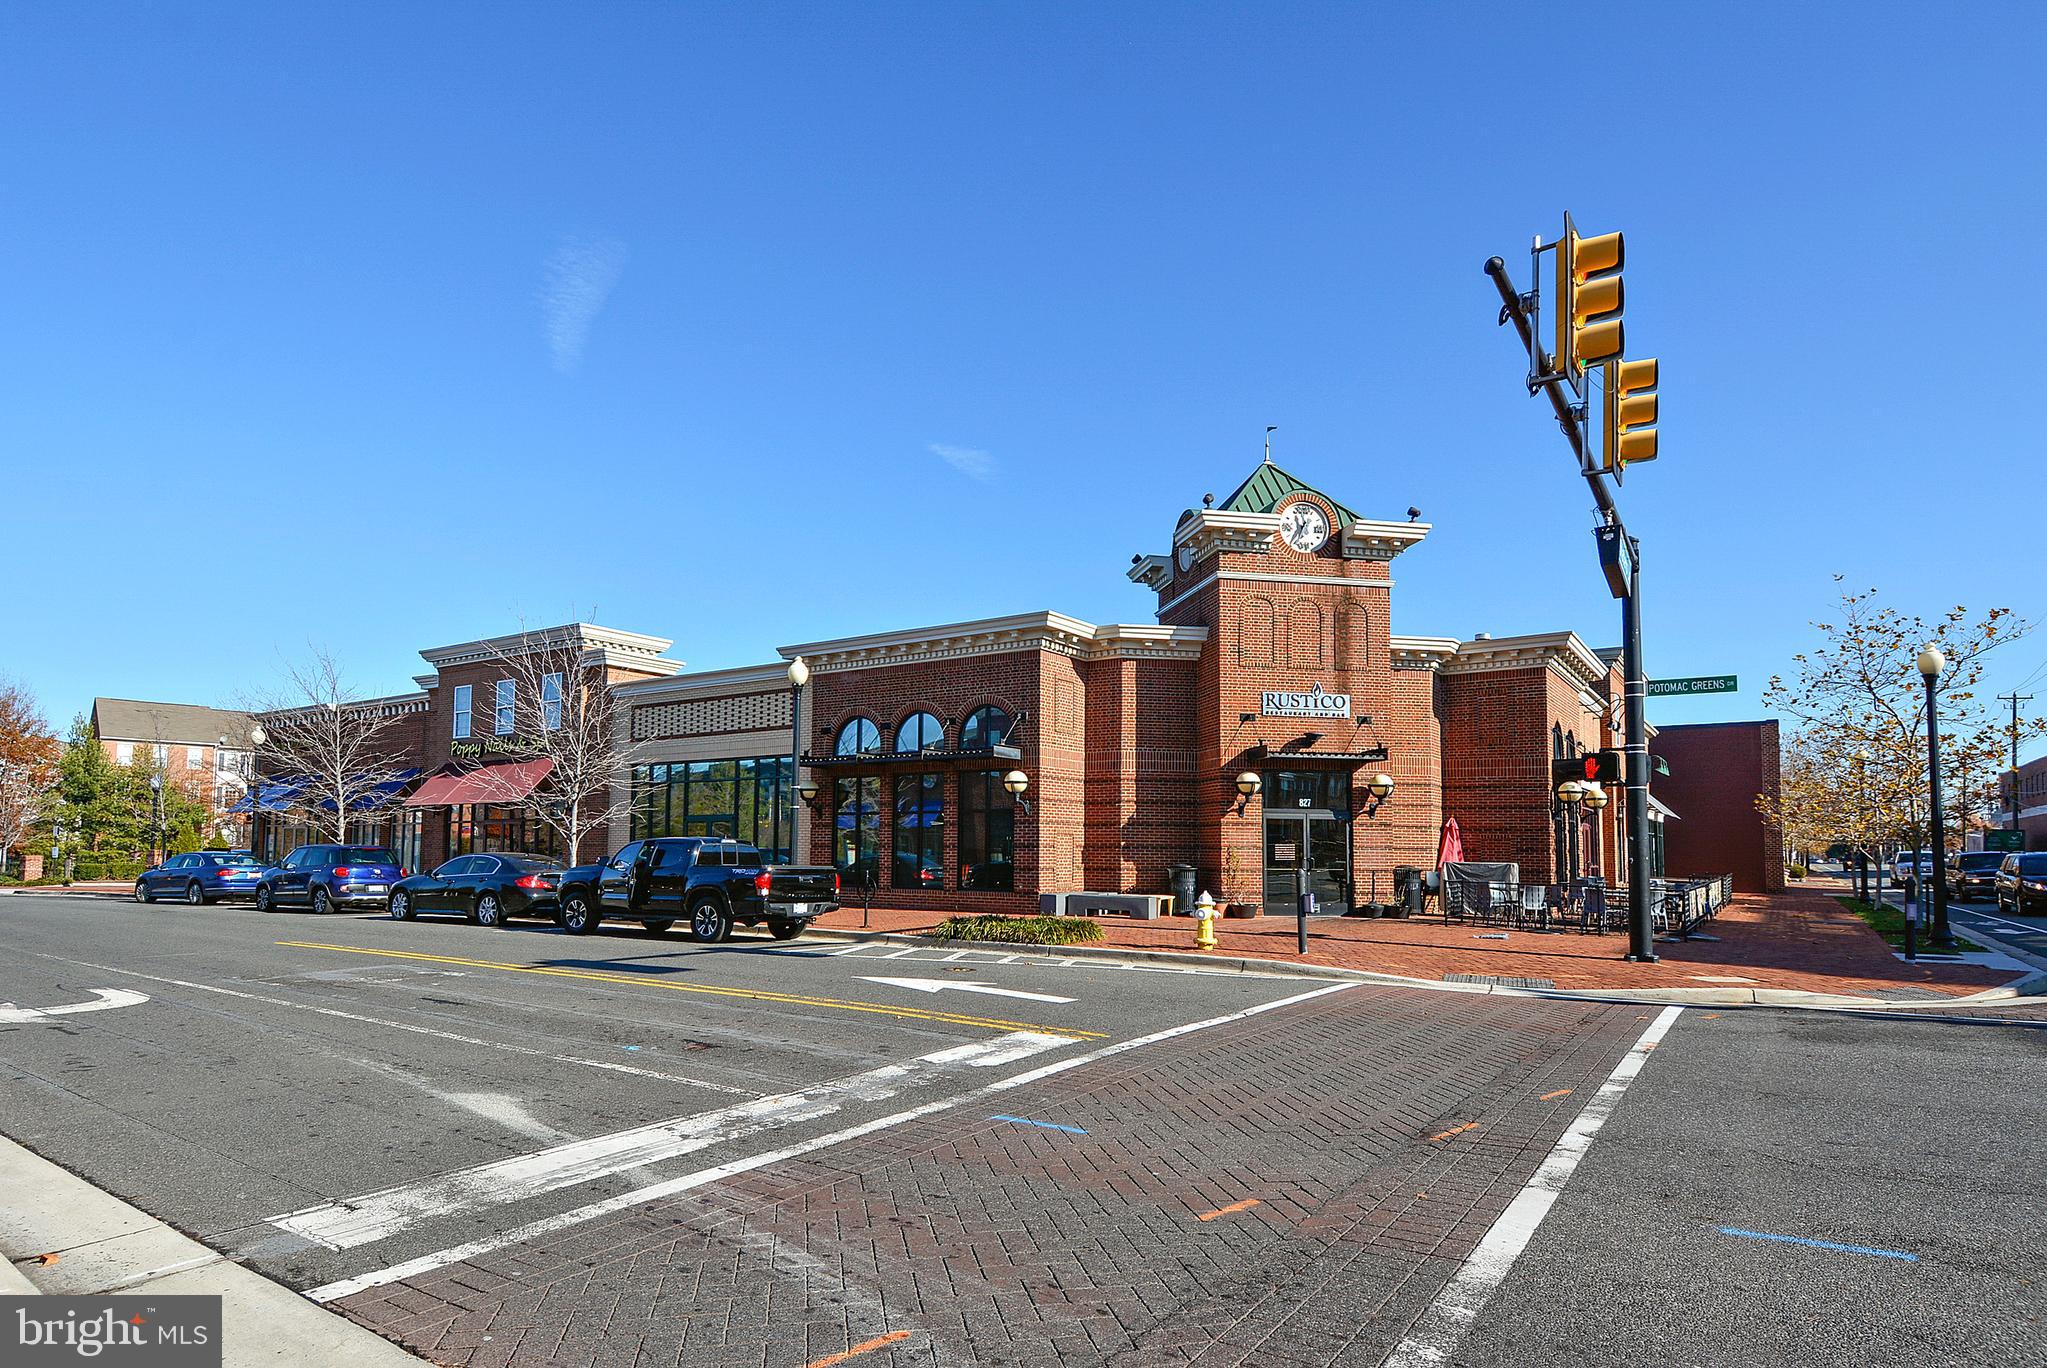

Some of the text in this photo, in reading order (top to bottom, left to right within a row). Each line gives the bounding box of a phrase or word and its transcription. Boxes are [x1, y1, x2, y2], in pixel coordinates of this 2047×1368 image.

[1648, 682, 1689, 693] POTOMAC
[1691, 680, 1725, 691] GREENS
[450, 740, 481, 759] Poppy
[1299, 798, 1311, 807] 827
